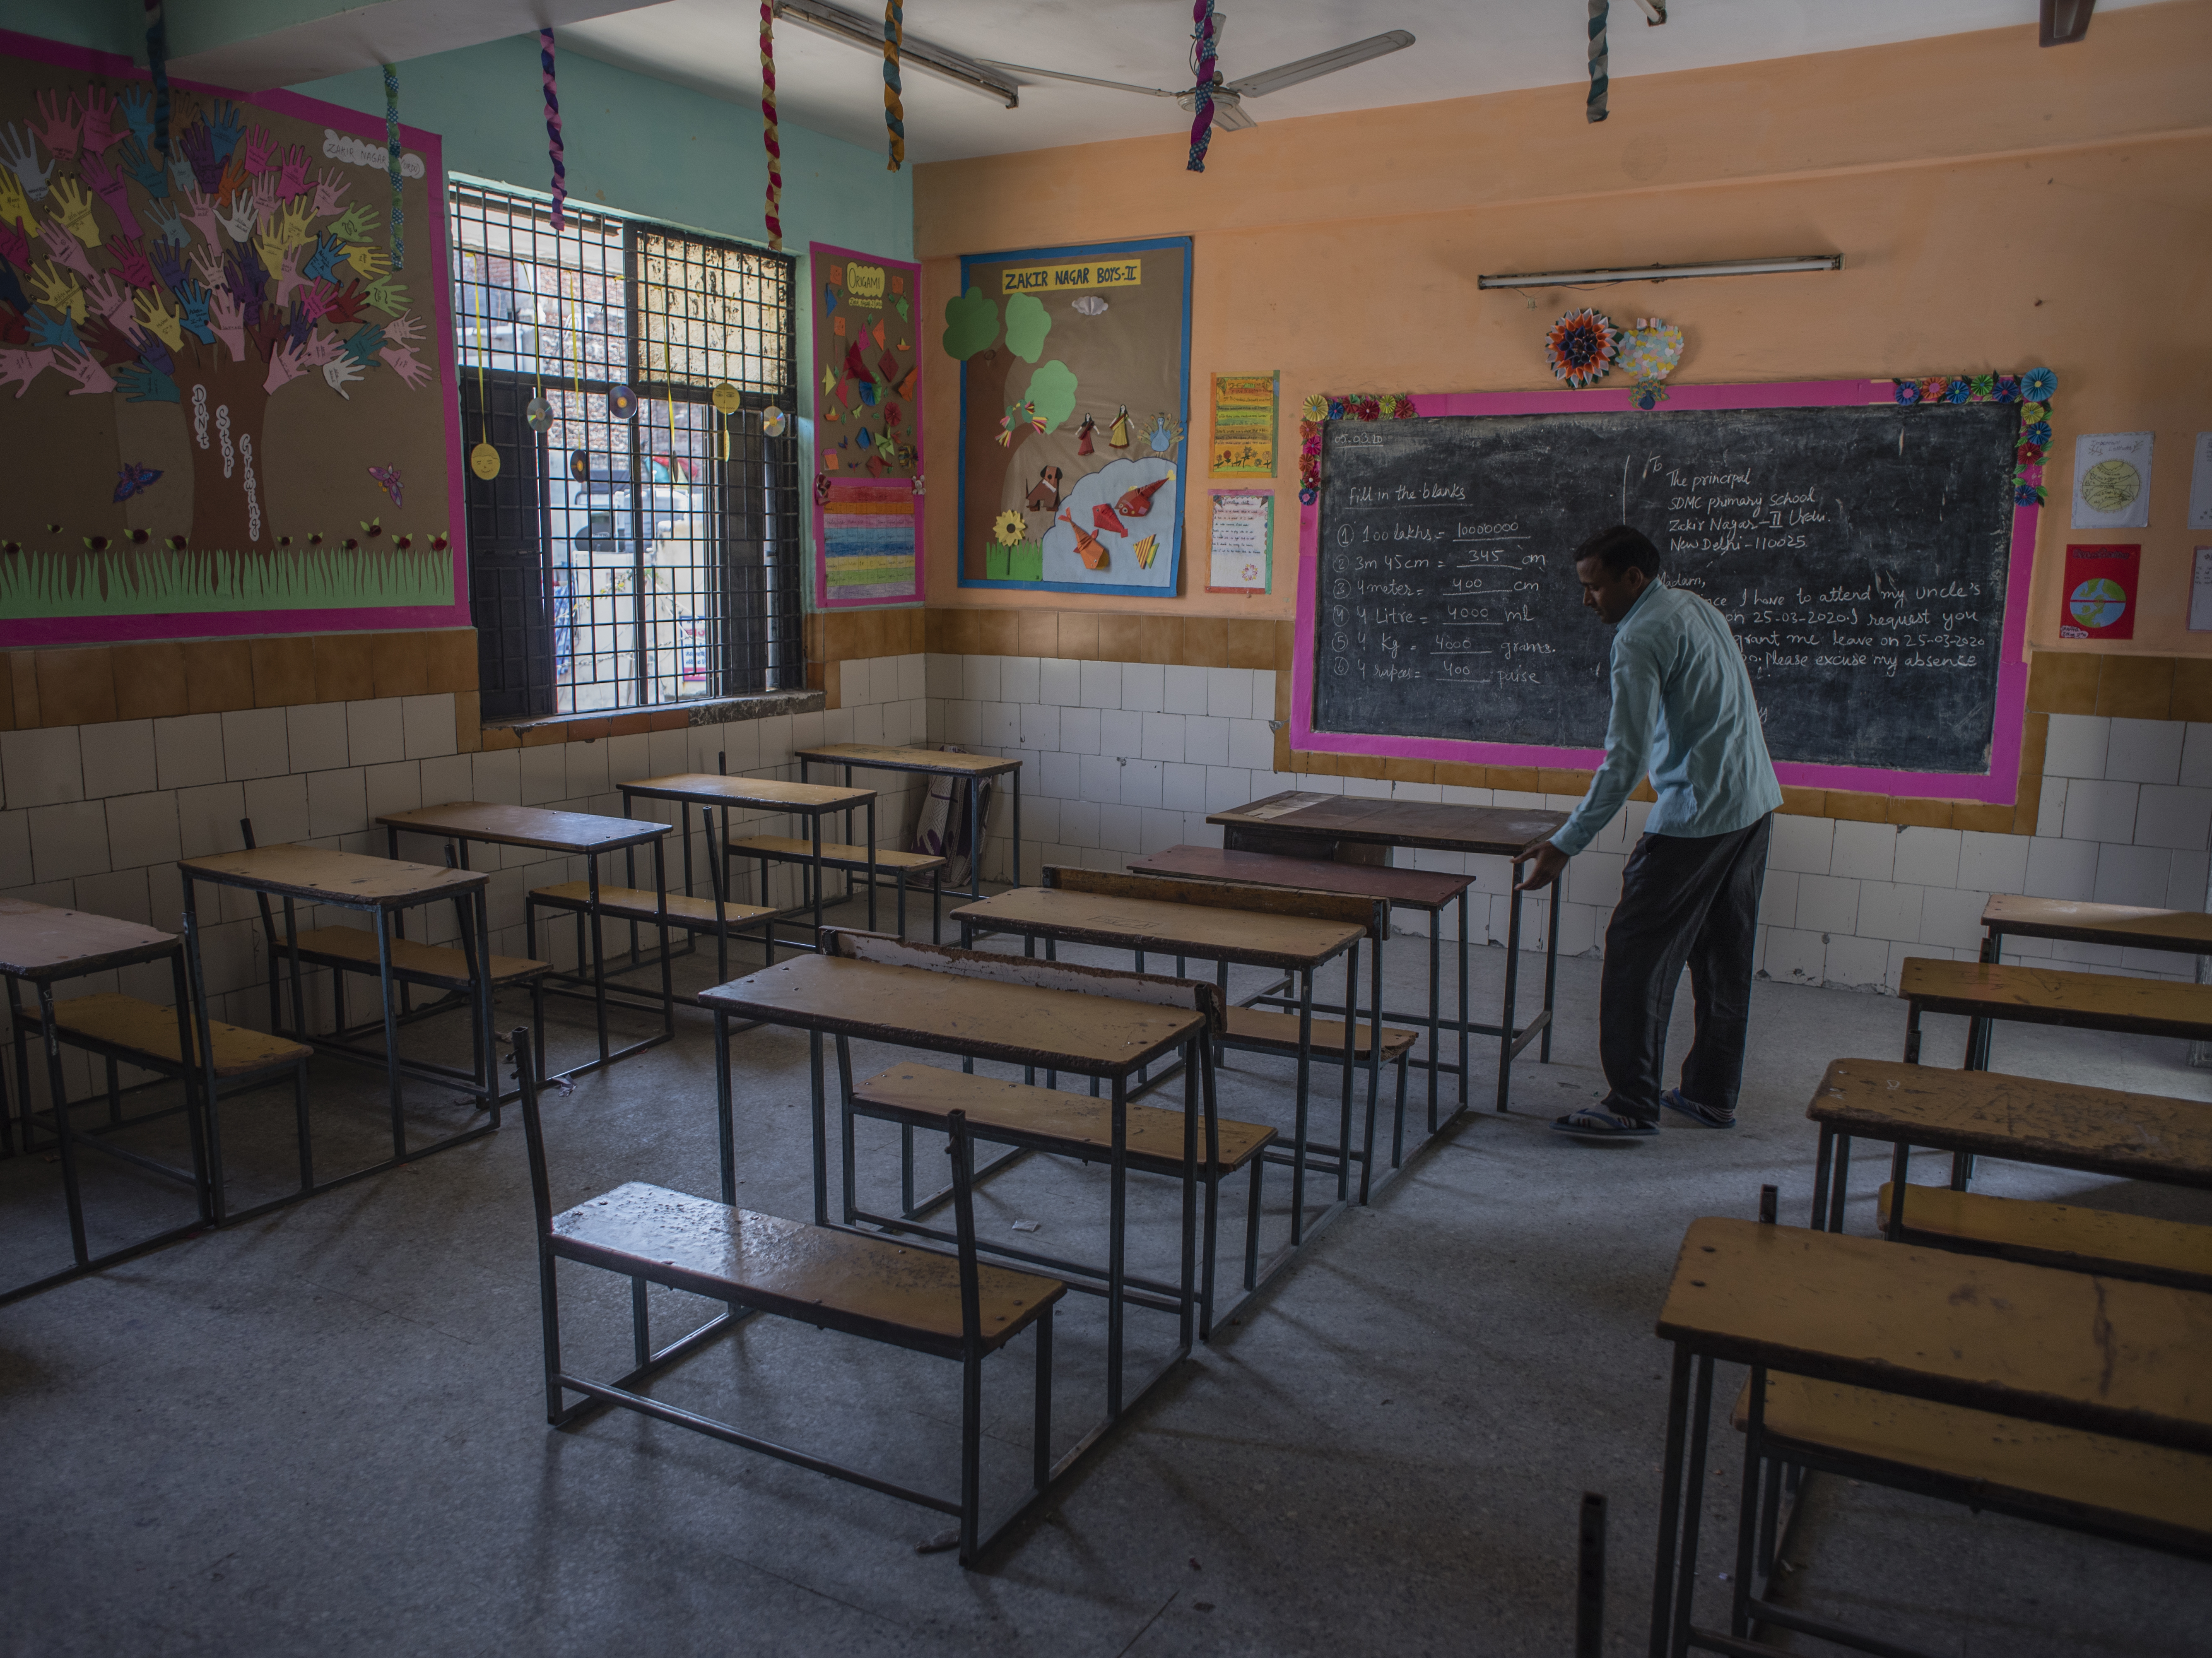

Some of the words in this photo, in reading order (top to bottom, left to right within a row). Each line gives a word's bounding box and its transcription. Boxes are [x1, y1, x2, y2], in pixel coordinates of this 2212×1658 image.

[326, 144, 355, 160] ZAKIR
[1005, 270, 1048, 290] ZAKIR
[1055, 267, 1090, 286] NAGAR
[1097, 265, 1137, 284] BOYS-II
[1666, 468, 1689, 487] The
[1378, 487, 1389, 501] in
[1395, 484, 1417, 501] the
[1422, 482, 1466, 500] blanks
[1667, 496, 1703, 510] SDMC
[1363, 525, 1388, 542] 100
[1469, 550, 1505, 562] 345
[1522, 553, 1546, 566] cm
[1453, 578, 1482, 588] 400
[1513, 580, 1539, 592] cm
[1740, 588, 1747, 607] I
[1754, 588, 1785, 606] have
[1797, 587, 1811, 604] to
[1819, 584, 1871, 602] attend
[1880, 589, 1904, 609] my
[1448, 607, 1489, 621] 4000
[1505, 604, 1535, 622] ml
[1867, 609, 1931, 630] request
[1942, 611, 1979, 631] you
[1436, 635, 1472, 650] 4000
[1786, 634, 1820, 645] me
[1833, 630, 1873, 646] leave
[1880, 637, 1899, 647] on
[1816, 654, 1867, 667] excuse
[1873, 655, 1898, 678] my
[1904, 651, 1977, 667] absence
[1443, 660, 1470, 676] 400
[1497, 670, 1541, 689] paise
